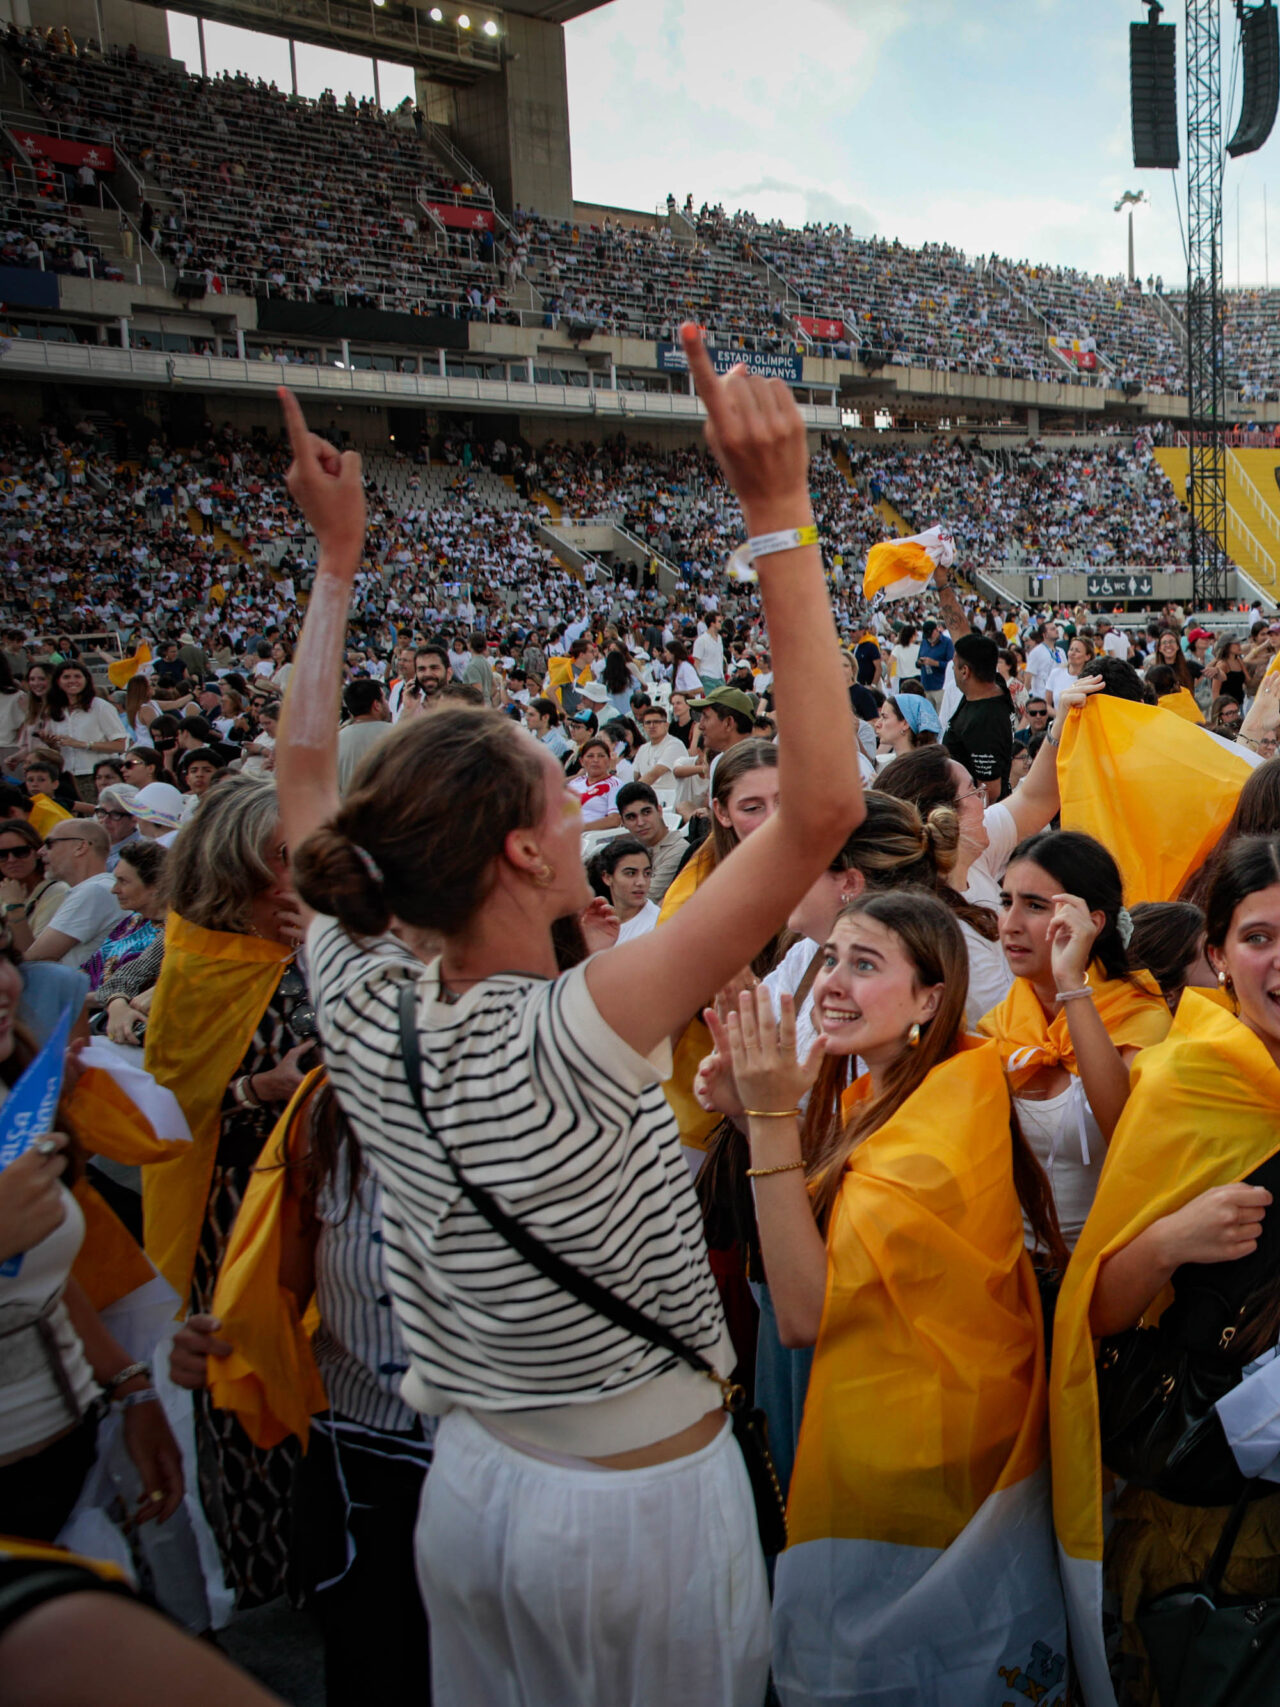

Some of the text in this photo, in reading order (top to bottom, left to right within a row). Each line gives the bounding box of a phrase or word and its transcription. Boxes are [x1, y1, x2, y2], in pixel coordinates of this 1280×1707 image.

[718, 350, 794, 367] ESTADI OLÍMPIC
[745, 365, 797, 379] COMPANYS
[1114, 582, 1126, 590] WC
